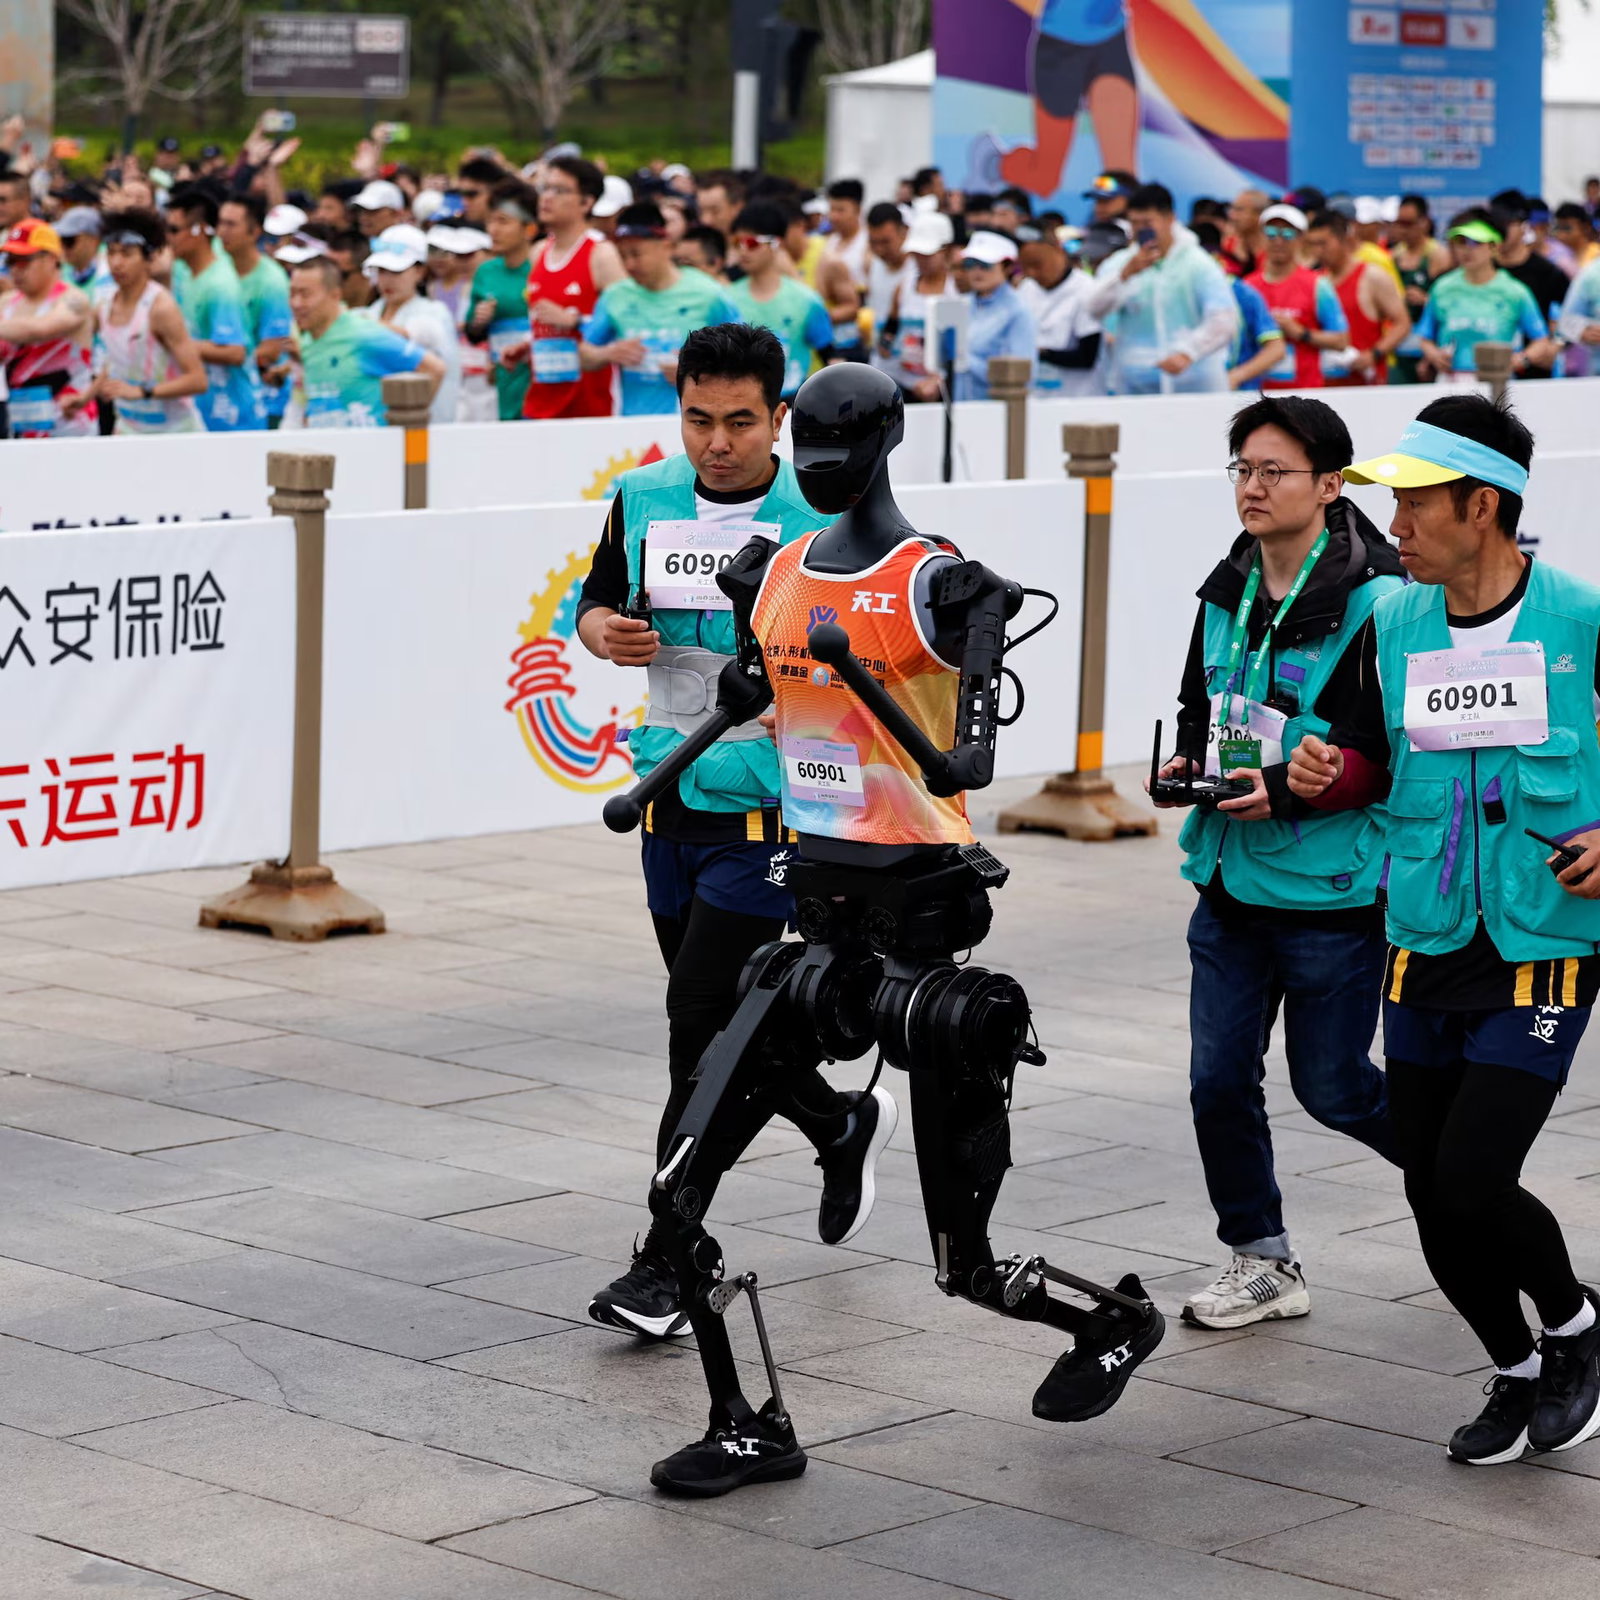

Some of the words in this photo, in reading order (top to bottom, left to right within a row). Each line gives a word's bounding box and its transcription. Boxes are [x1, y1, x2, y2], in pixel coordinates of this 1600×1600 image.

[665, 553, 734, 575] 6090
[850, 590, 897, 614] 天工
[1427, 682, 1517, 713] 60901
[797, 761, 847, 783] 60901
[1098, 1340, 1133, 1372] 天工
[721, 1437, 760, 1456] 天工
